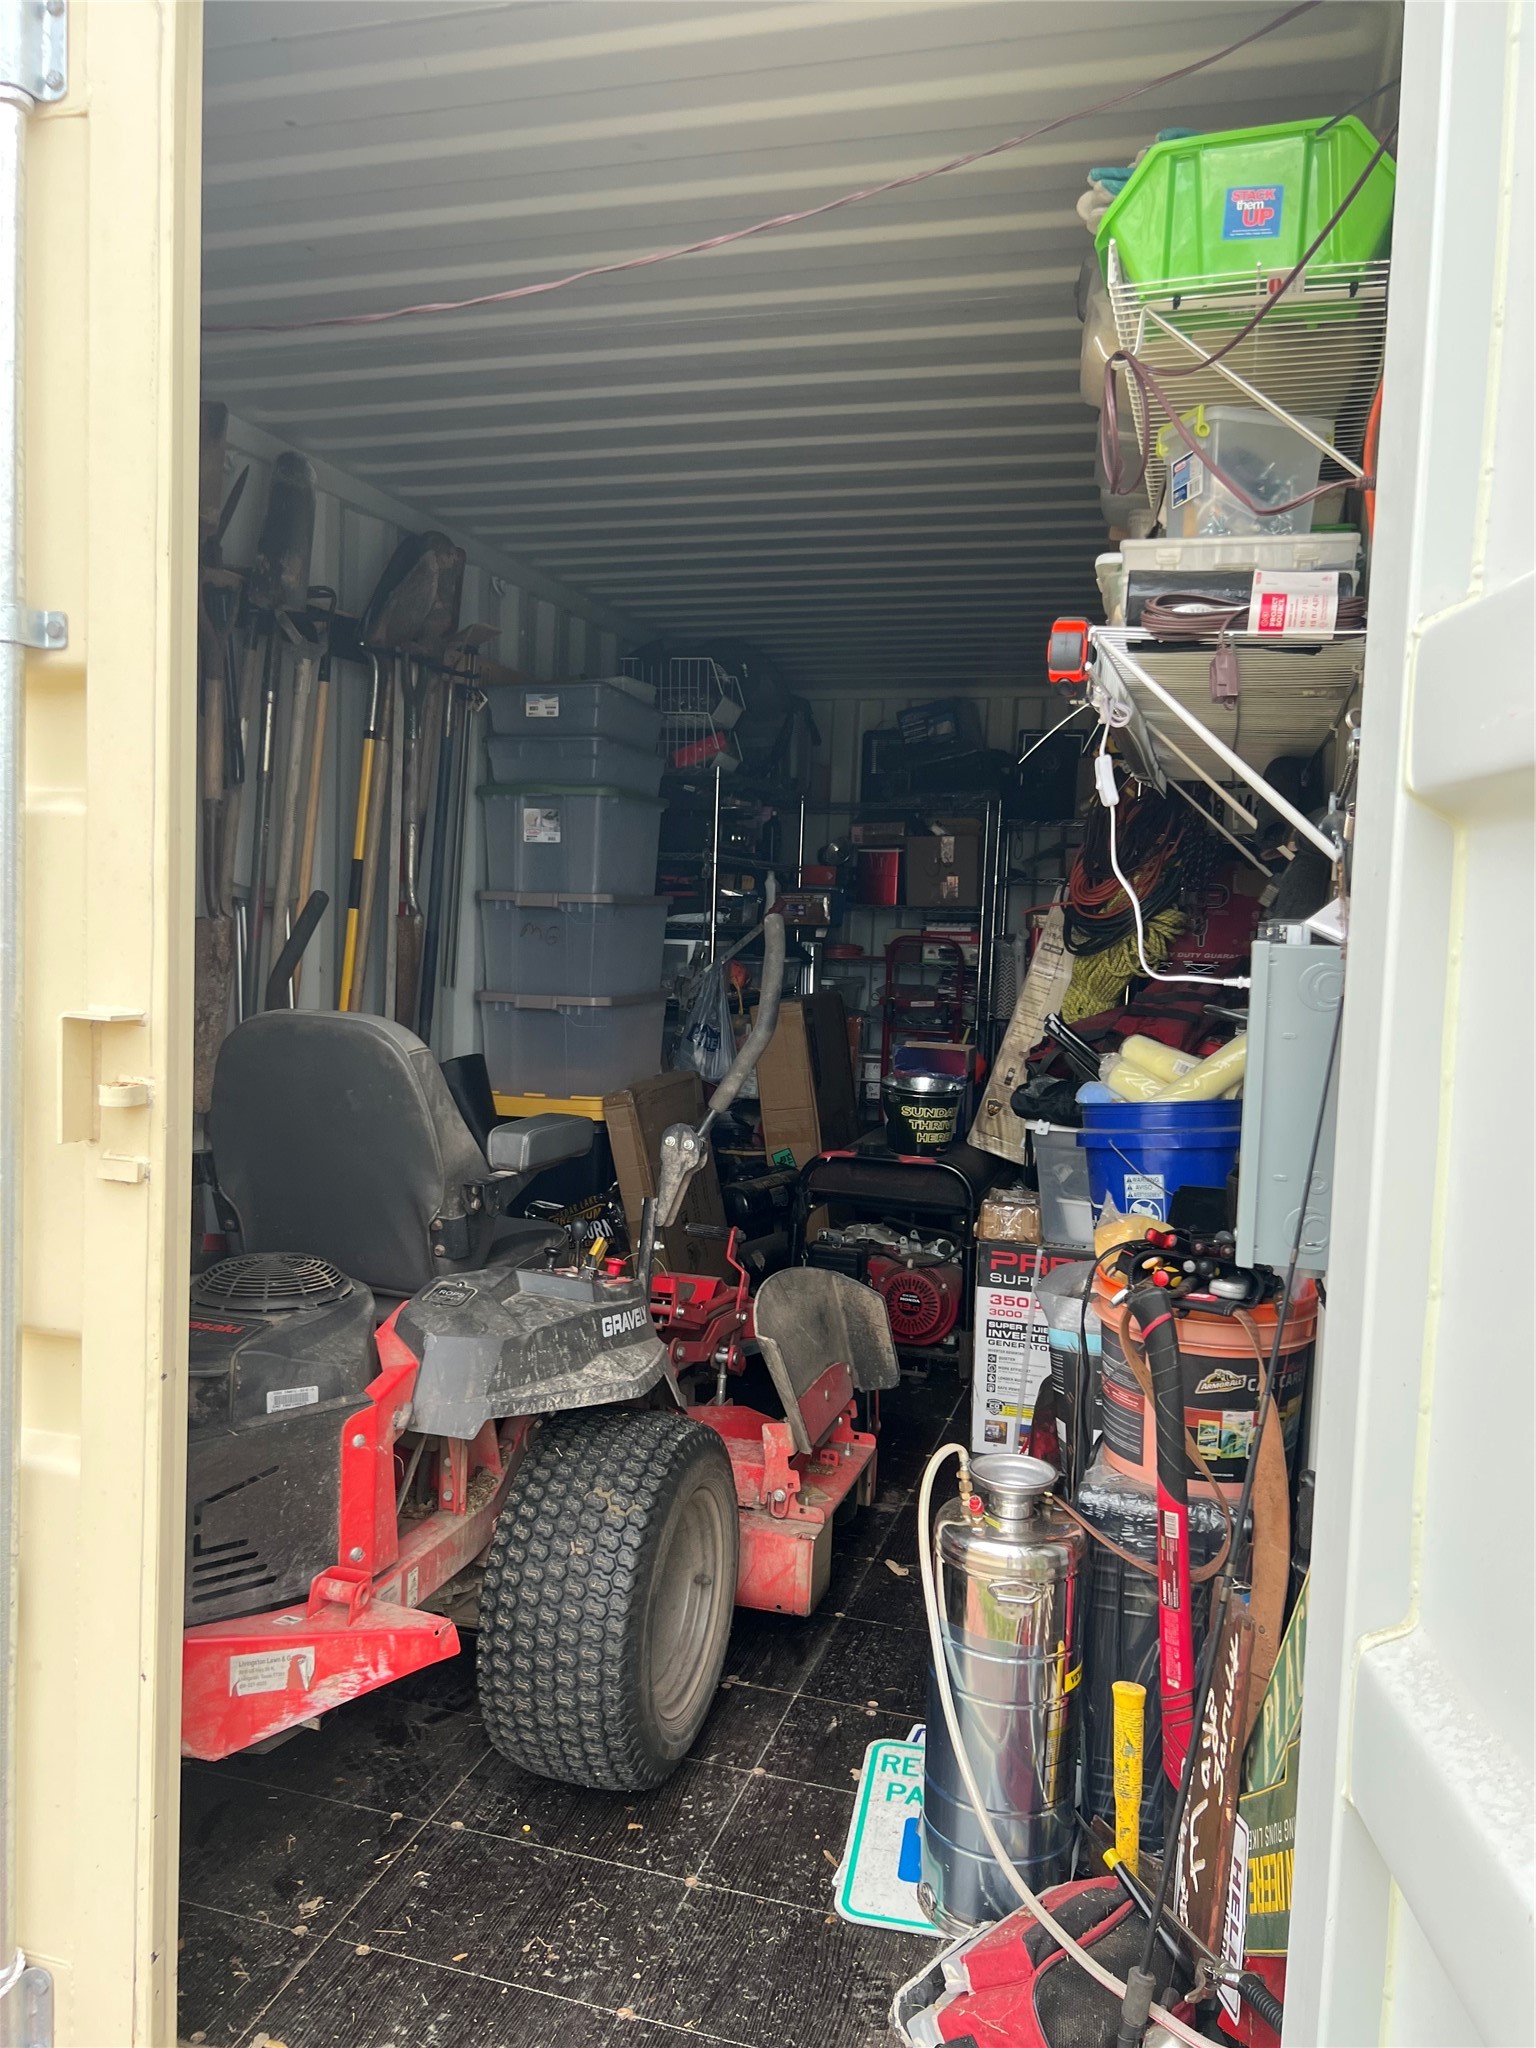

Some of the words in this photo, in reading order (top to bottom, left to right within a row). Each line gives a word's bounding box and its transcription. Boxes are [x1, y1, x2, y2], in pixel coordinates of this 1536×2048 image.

[1231, 188, 1276, 203] STACK
[1236, 199, 1264, 210] them
[1242, 207, 1274, 227] UP
[1269, 596, 1279, 627] PROJECT
[899, 1296, 921, 1304] HONDA
[602, 1305, 648, 1338] GRAVELY
[989, 1308, 1023, 1319] 3000
[988, 1321, 1023, 1331] SUPER
[881, 1753, 925, 1777] RE
[1265, 1821, 1283, 1847] RUNS
[1248, 1851, 1286, 1915] DEERE
